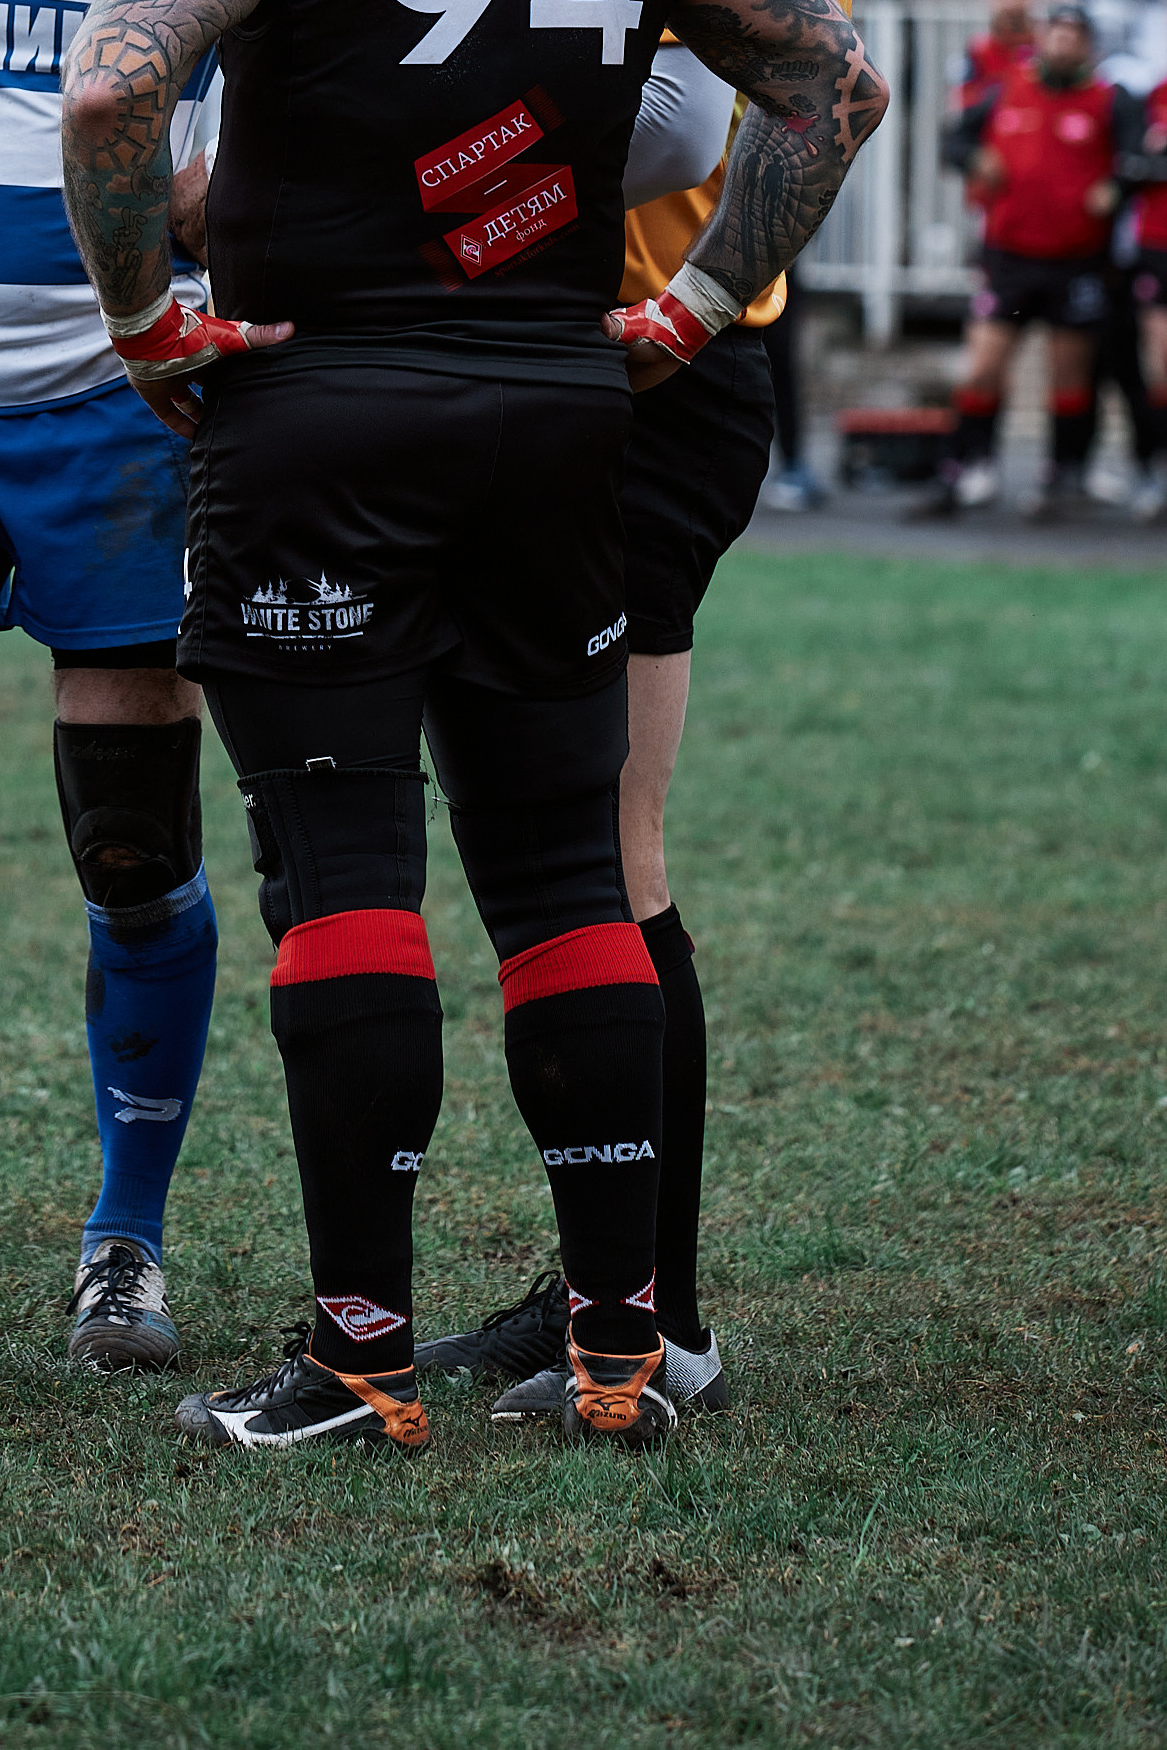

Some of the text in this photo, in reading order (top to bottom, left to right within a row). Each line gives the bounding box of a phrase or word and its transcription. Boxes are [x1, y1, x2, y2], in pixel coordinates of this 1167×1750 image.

[421, 112, 532, 188] СПАРТАК
[483, 182, 568, 247] ДЕТЯМ
[515, 218, 548, 243] фонд
[308, 603, 374, 631] STONE
